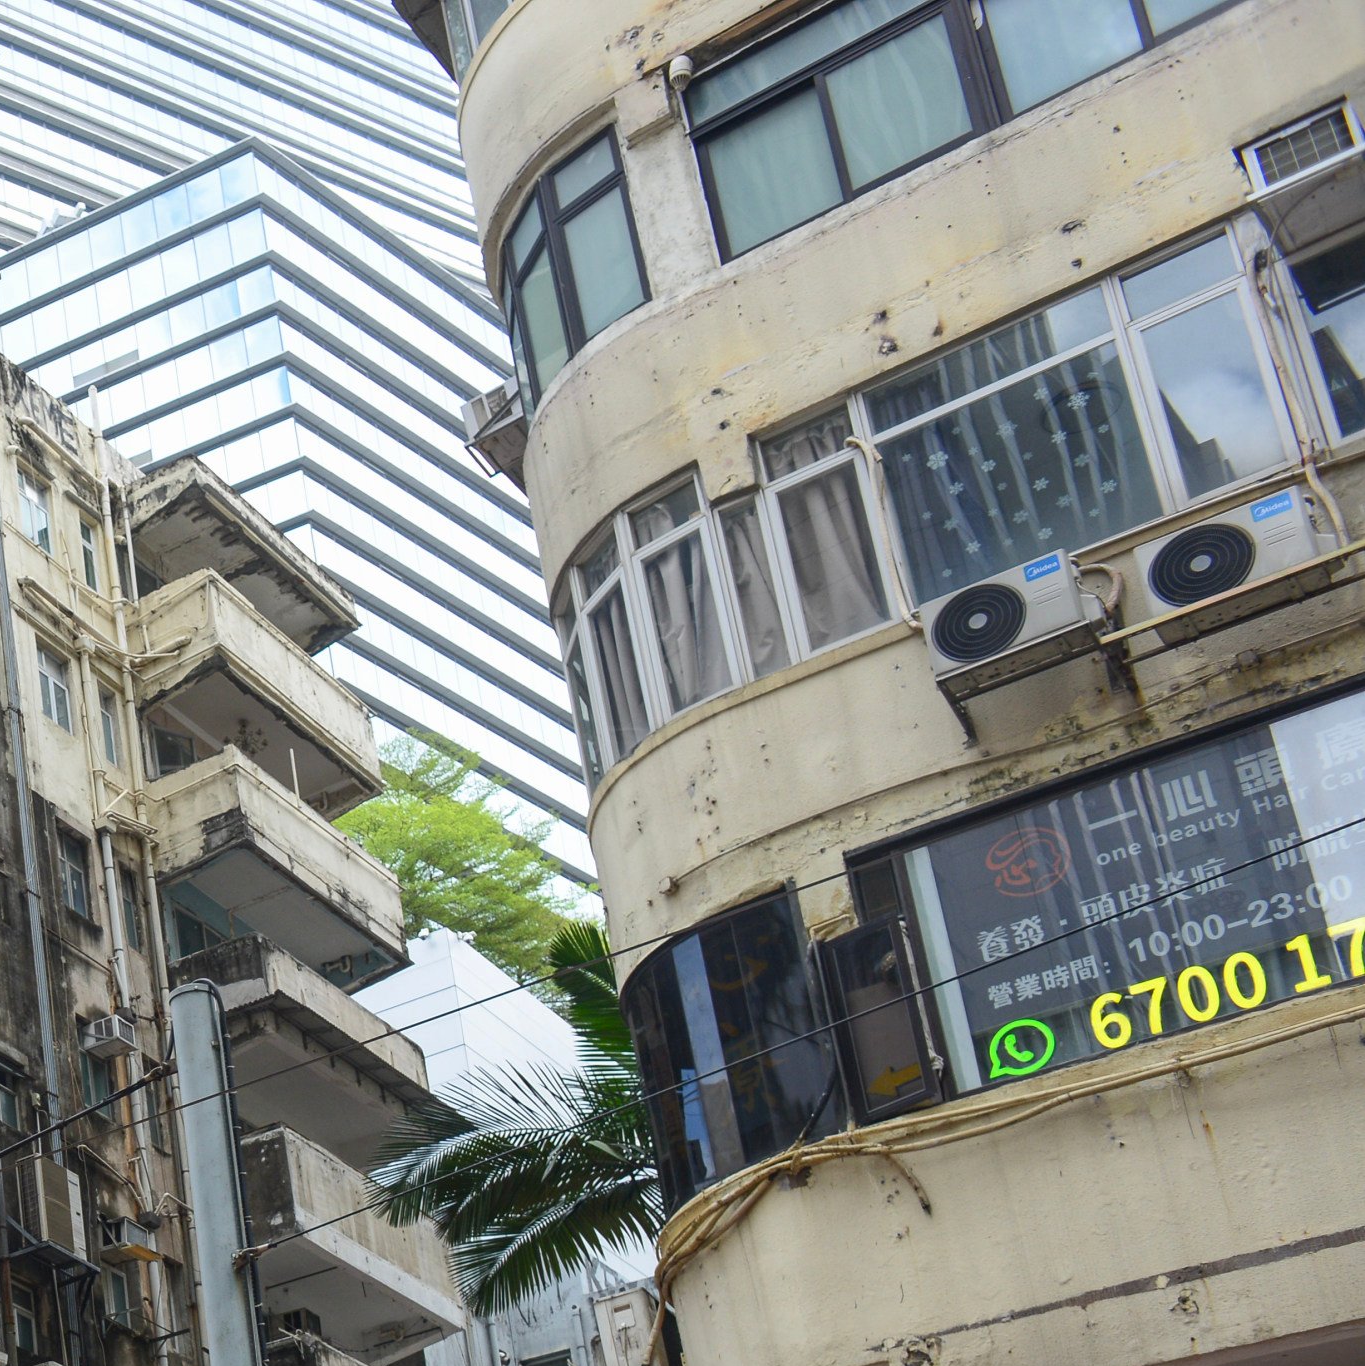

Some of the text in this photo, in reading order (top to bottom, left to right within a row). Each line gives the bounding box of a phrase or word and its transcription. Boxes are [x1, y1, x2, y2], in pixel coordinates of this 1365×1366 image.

[1254, 499, 1290, 517] Midea
[1027, 560, 1058, 577] Midea
[1096, 843, 1142, 866] one
[1152, 808, 1241, 848] beauty
[1251, 785, 1308, 815] Hair
[1090, 951, 1267, 1049] 6700
